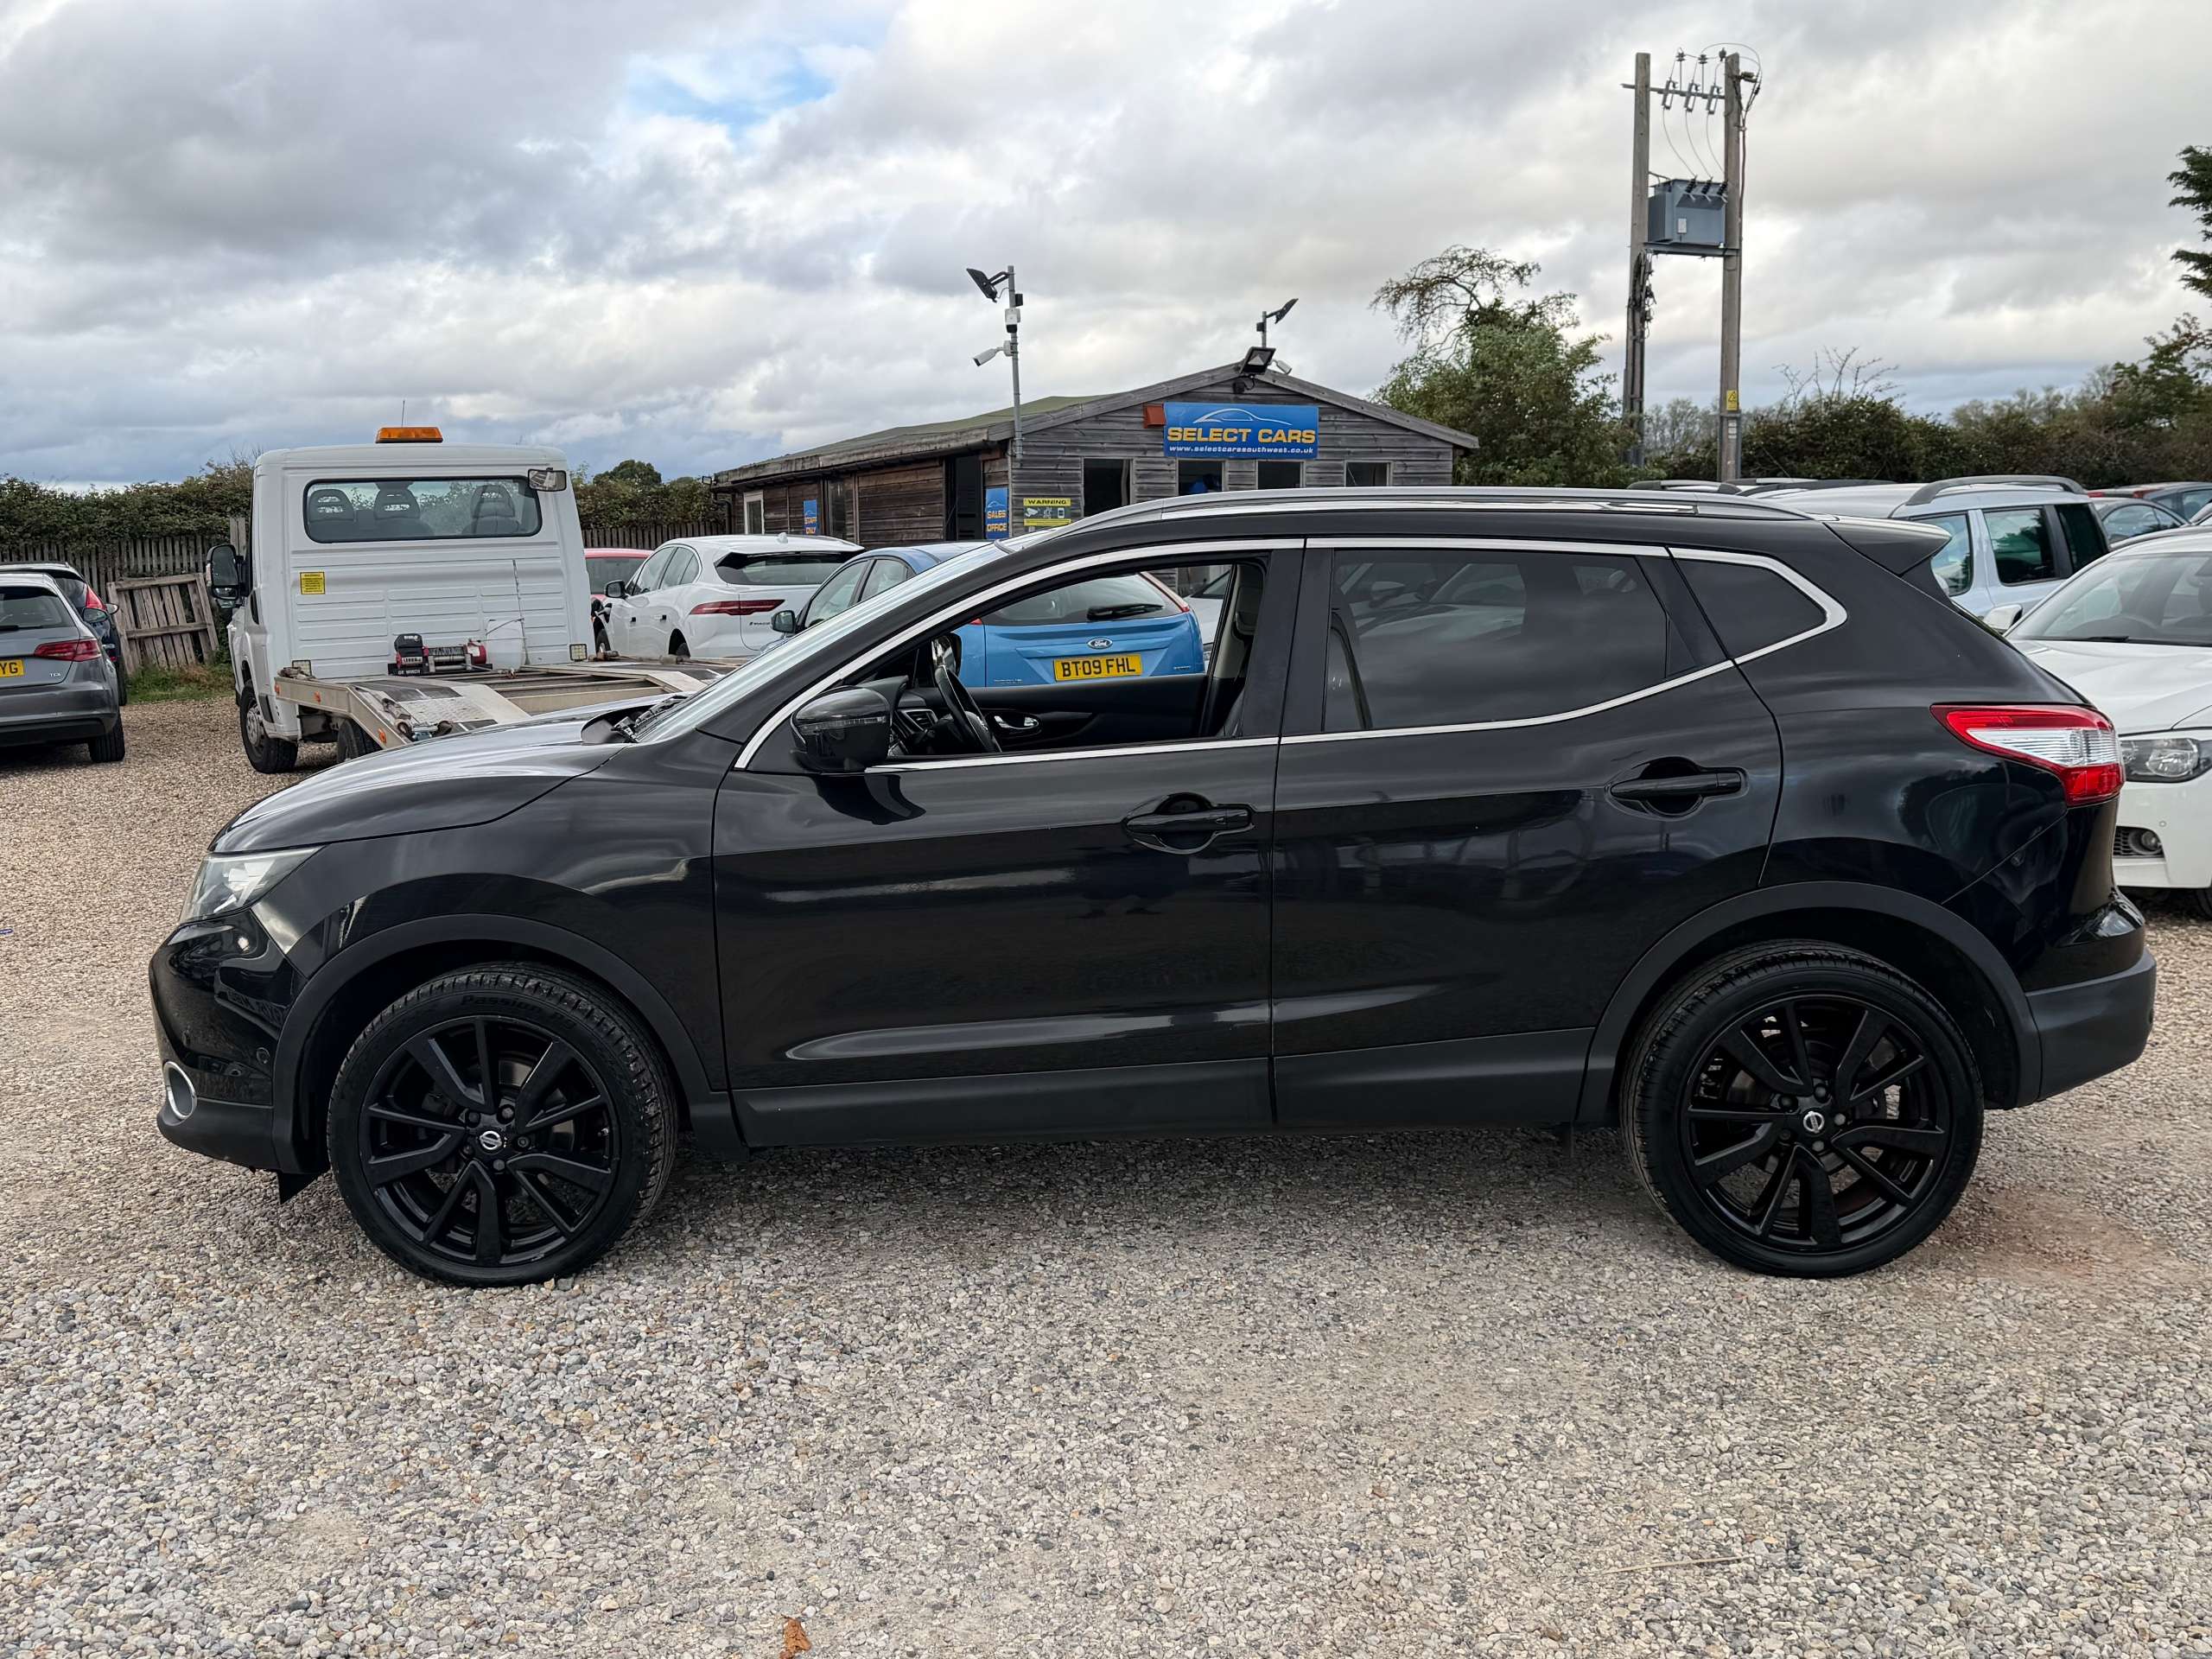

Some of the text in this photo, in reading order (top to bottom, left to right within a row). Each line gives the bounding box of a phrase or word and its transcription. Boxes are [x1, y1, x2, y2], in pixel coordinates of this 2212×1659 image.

[1167, 427, 1316, 444] SELECT CARS
[1169, 445, 1313, 454] www.selectcarssouthwest.co.uk
[0, 662, 18, 675] YG
[1061, 656, 1136, 677] BT09 FHL
